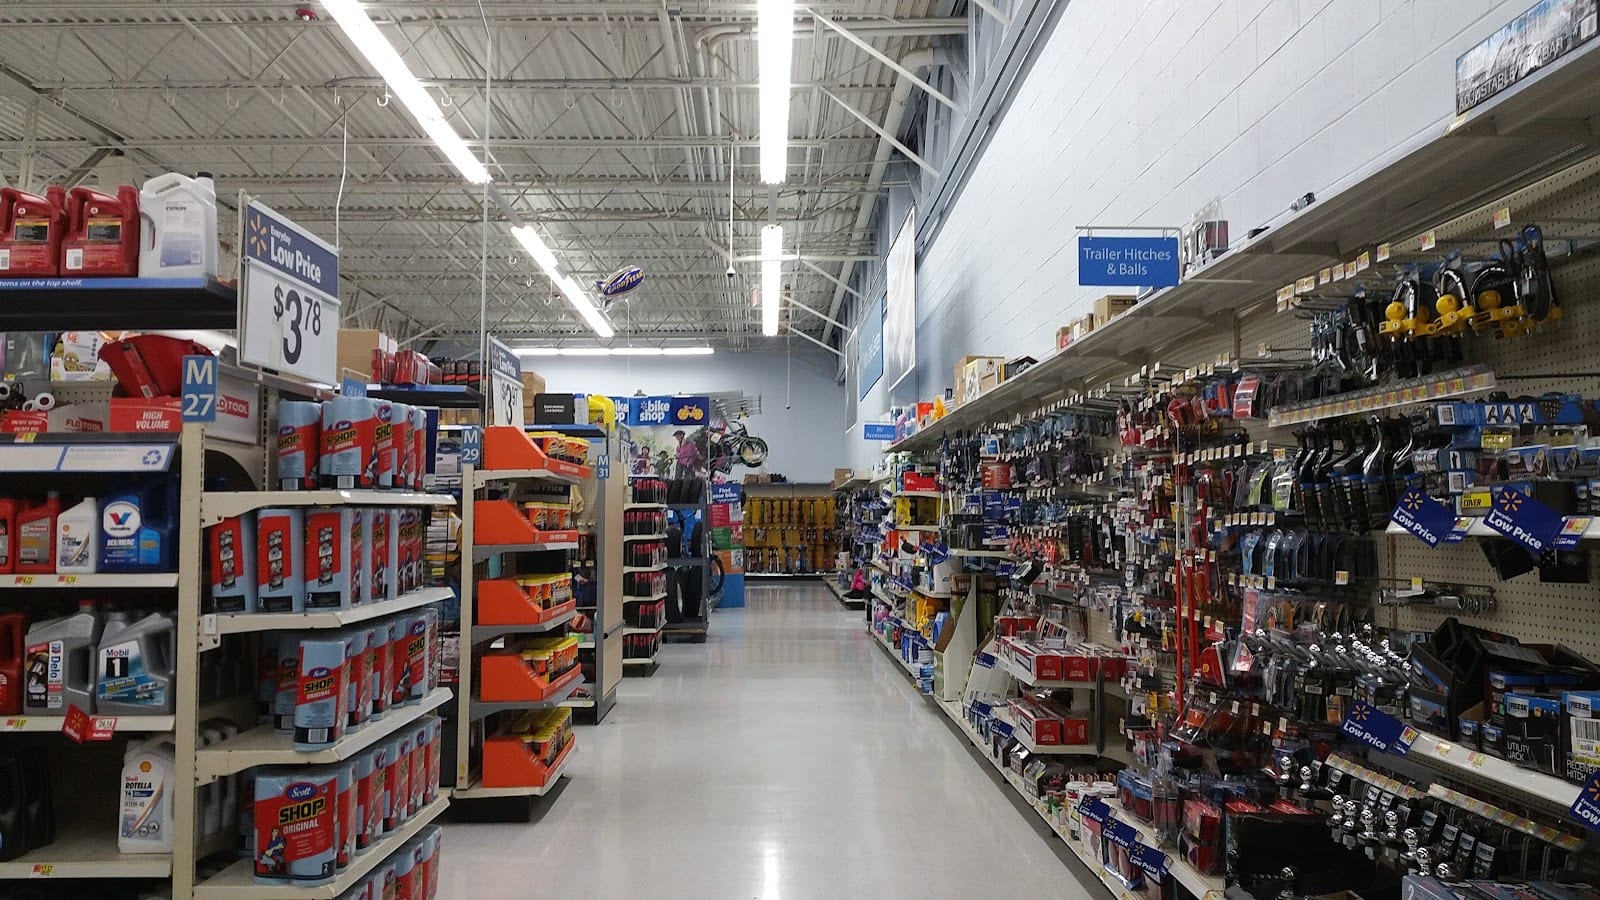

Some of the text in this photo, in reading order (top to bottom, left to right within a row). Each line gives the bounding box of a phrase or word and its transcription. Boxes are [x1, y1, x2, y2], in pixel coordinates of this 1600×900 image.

[270, 225, 291, 246] Everyday
[270, 236, 321, 284] Low Price
[1083, 247, 1171, 261] Trailer Hitches
[1106, 262, 1147, 276] & Balls
[185, 359, 213, 385] M
[183, 393, 214, 417] 27
[615, 400, 629, 413] ike
[648, 400, 670, 412] bike
[142, 411, 163, 420] HIGH
[615, 412, 626, 423] op
[640, 409, 665, 424] shop
[136, 420, 170, 430] VOLUME
[376, 423, 392, 440] SHO
[334, 429, 357, 441] SHOP
[464, 430, 478, 444] M
[462, 449, 479, 461] 29
[598, 456, 609, 465] M
[598, 468, 609, 477] 31
[1463, 499, 1482, 507] COVER
[1393, 510, 1414, 528] Low
[1413, 523, 1437, 544] Price
[1488, 512, 1542, 549] Low Price
[106, 648, 130, 657] Mobil
[408, 636, 425, 656] SHO
[50, 656, 61, 679] Delo
[112, 658, 121, 677] 1
[312, 670, 327, 678] Scott
[304, 678, 334, 692] SHOP
[306, 689, 331, 700] ORIGINAL
[1510, 702, 1528, 711] REESE
[1571, 702, 1590, 711] REESE
[1343, 722, 1387, 750] Low Price
[1507, 742, 1530, 753] UTILITY
[1507, 751, 1524, 761] JACK
[1566, 770, 1587, 782] HITCH
[291, 786, 312, 798] Scott
[280, 797, 325, 824] SHOP
[1575, 801, 1600, 826] Low
[283, 818, 319, 835] ORIGINAL
[1102, 829, 1129, 847] Low Price
[323, 863, 329, 873] 2
[1129, 856, 1157, 873] Low Price
